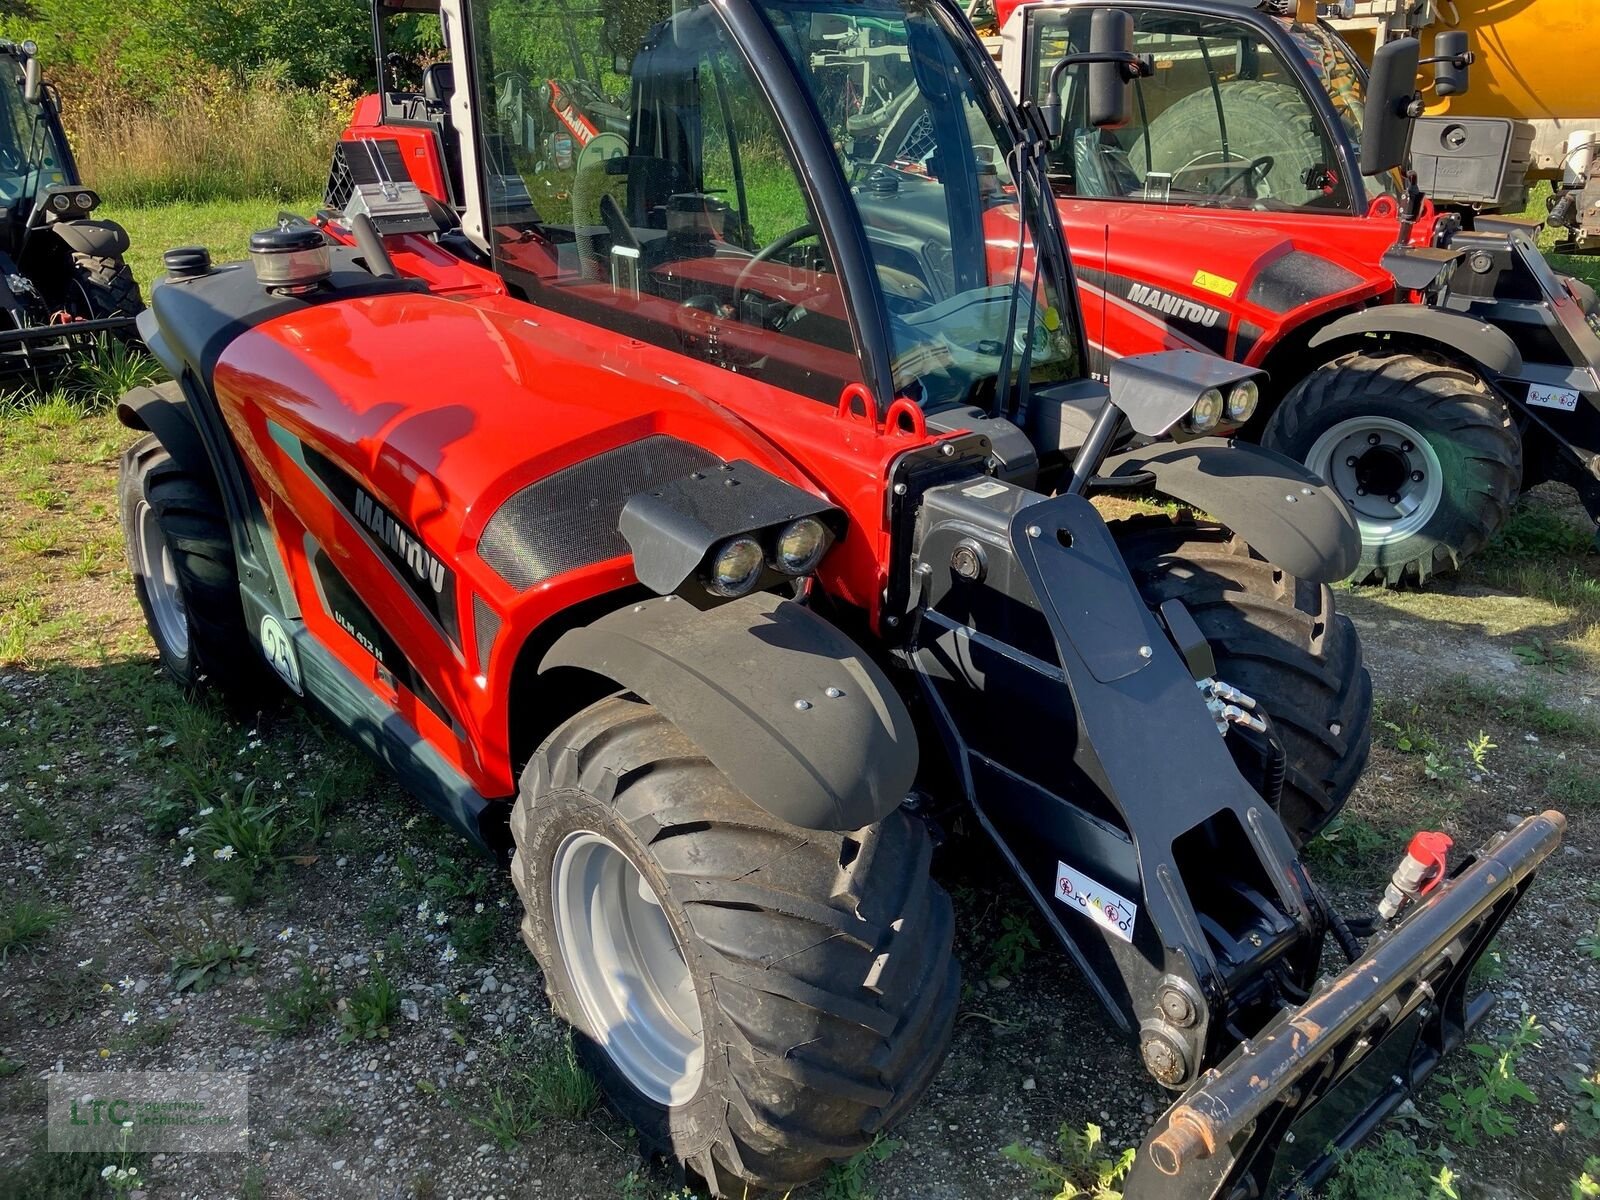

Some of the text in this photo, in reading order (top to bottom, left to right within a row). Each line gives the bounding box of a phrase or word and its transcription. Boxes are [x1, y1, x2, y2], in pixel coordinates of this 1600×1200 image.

[1127, 283, 1220, 328] MANITOU
[354, 487, 446, 593] MANITOU
[335, 611, 355, 636] ULM
[375, 647, 383, 662] H
